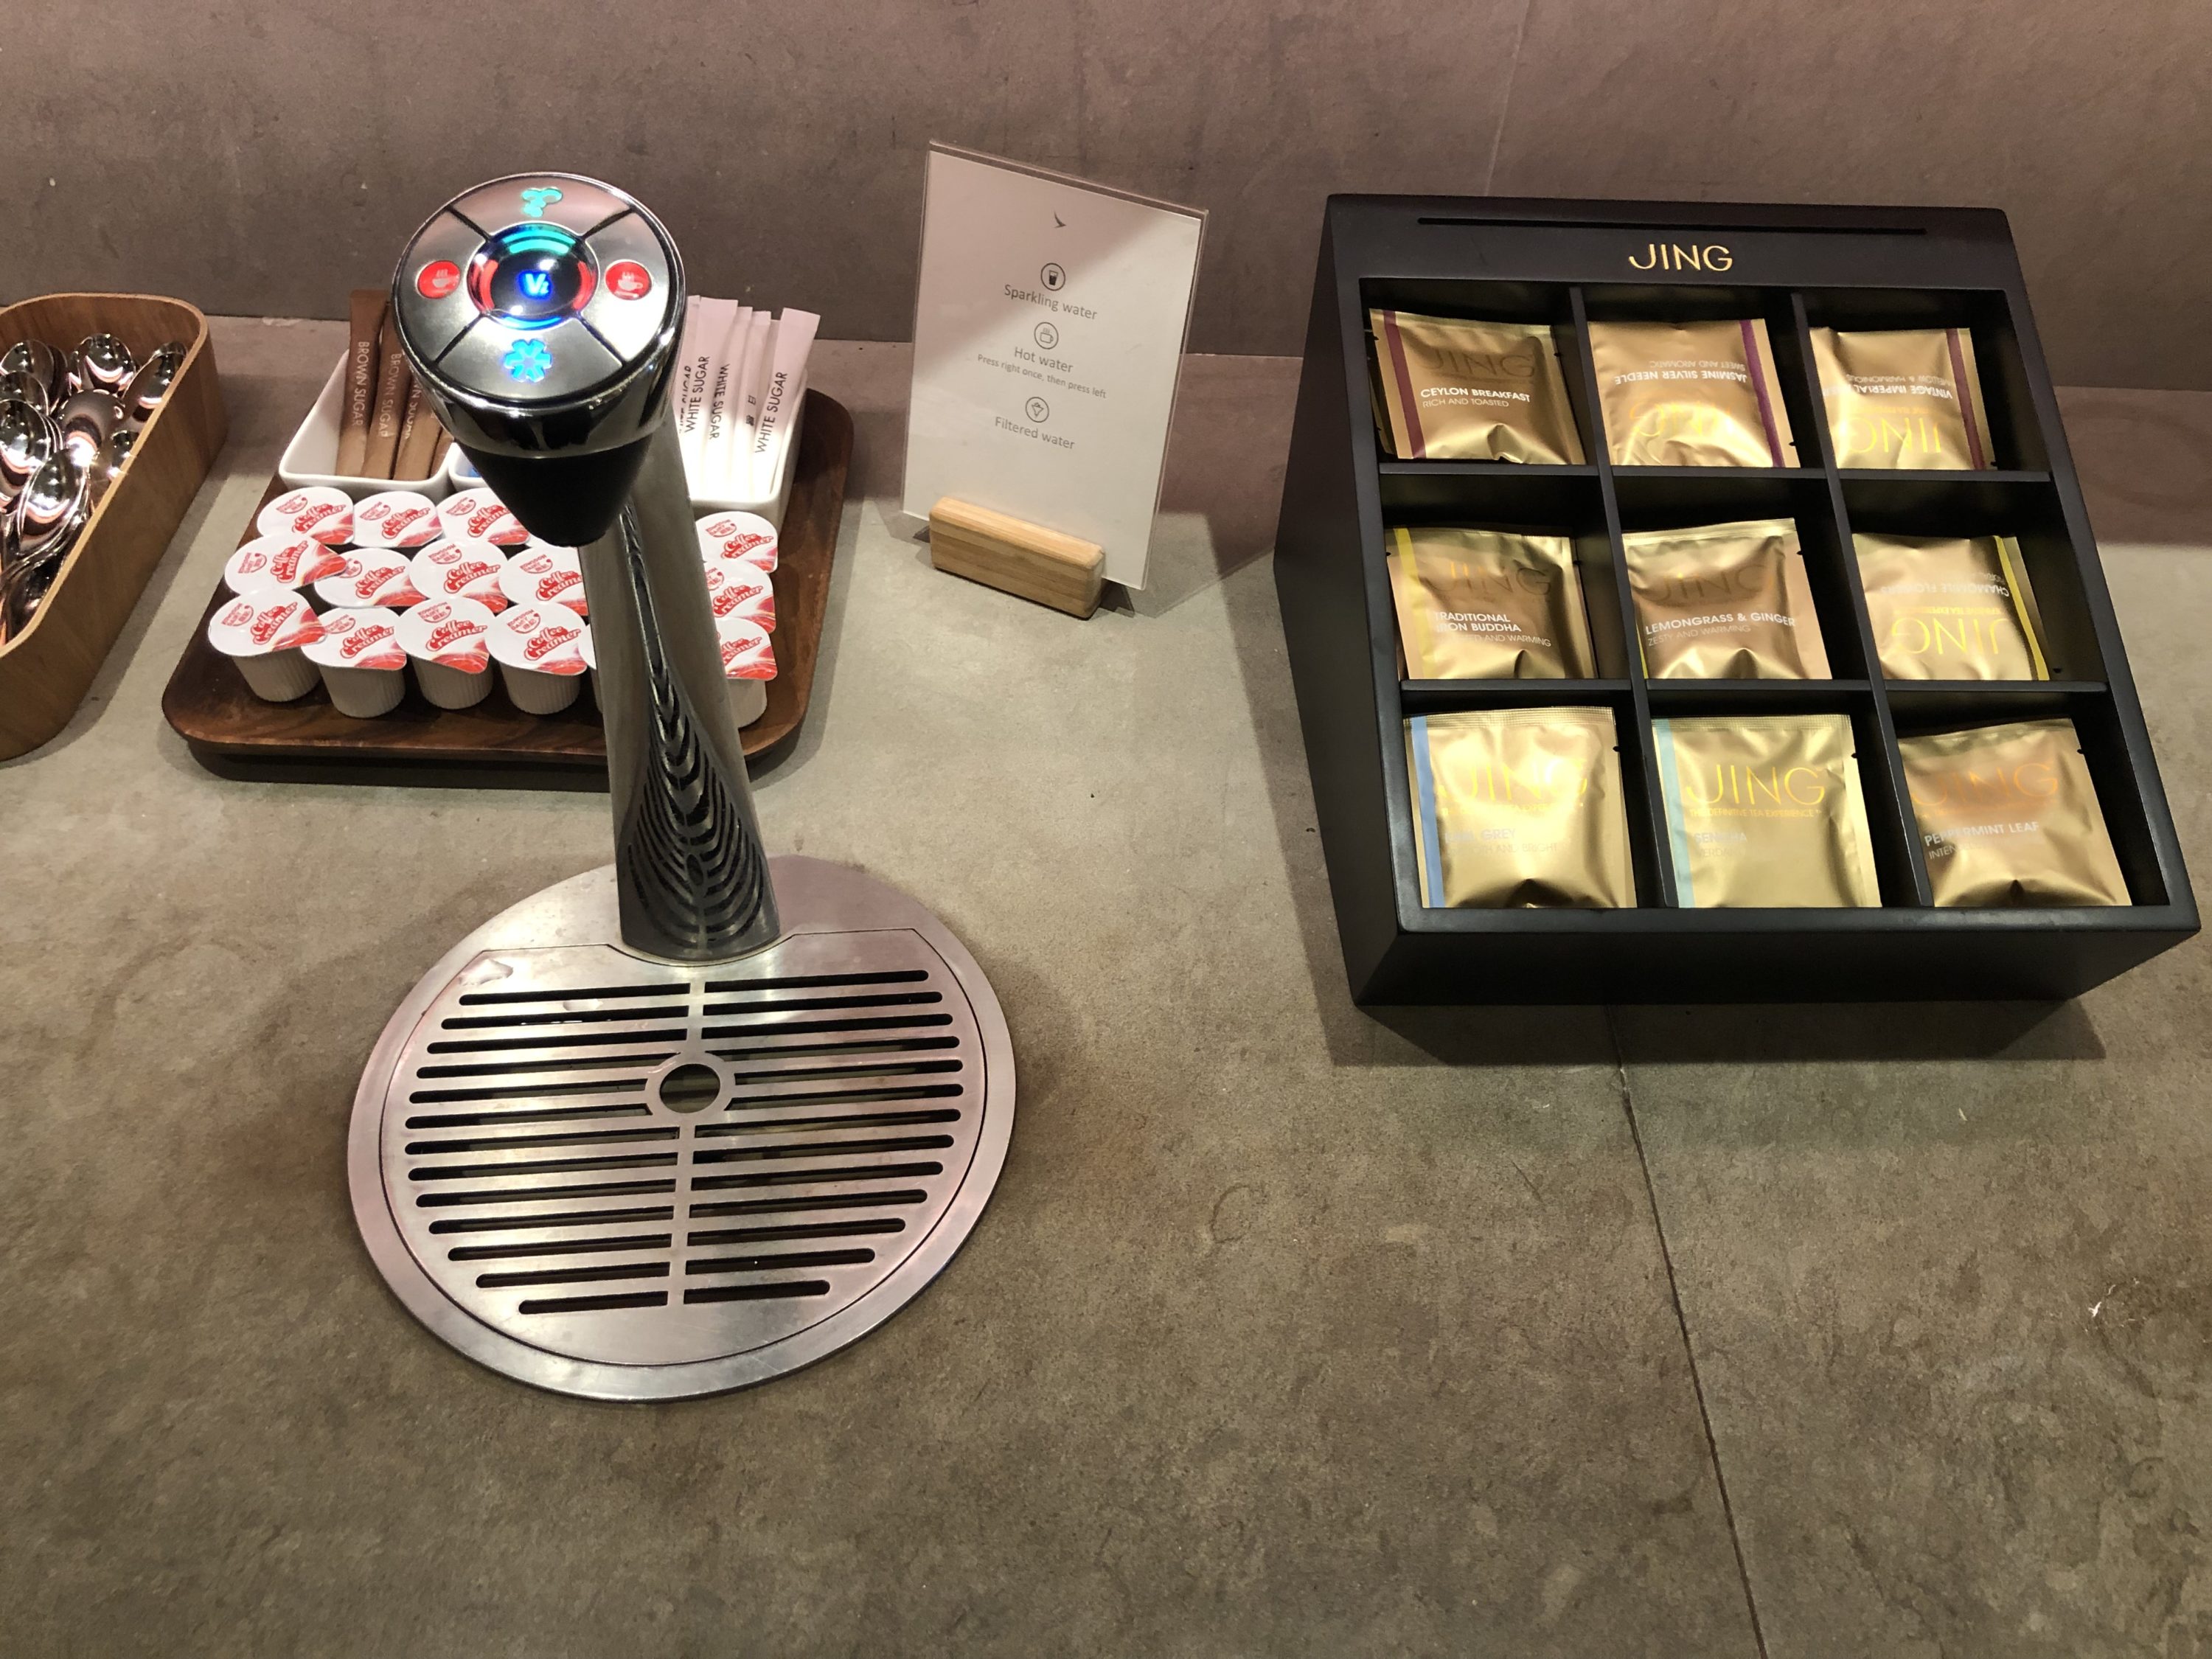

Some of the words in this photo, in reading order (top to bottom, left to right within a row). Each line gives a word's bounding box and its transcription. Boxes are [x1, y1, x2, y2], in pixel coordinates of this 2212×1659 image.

[1629, 244, 1732, 271] JING
[1004, 284, 1058, 312] Sparkling
[1062, 303, 1097, 319] water
[355, 341, 369, 386] BROWN
[1015, 347, 1035, 363] Hot
[1039, 356, 1074, 372] water
[1698, 361, 1719, 369] AND
[384, 353, 402, 395] BROWN
[692, 356, 710, 393] SUGAR
[714, 364, 730, 397] WHITE
[978, 354, 999, 367] Press
[1001, 361, 1020, 374] right
[1023, 368, 1044, 381] once,
[1047, 375, 1066, 386] then
[1068, 381, 1090, 394] press
[1093, 387, 1106, 398] left
[1615, 371, 1658, 385] NEEDLE
[1663, 370, 1699, 380] SILVER
[1702, 370, 1747, 383] JASMINE
[1420, 387, 1469, 398] CEYLON
[1471, 389, 1530, 403] BREAKFAST
[1854, 384, 1906, 394] IMPERIAL
[1911, 386, 1952, 399] VINTAGE
[352, 388, 366, 425] SUGAR
[684, 397, 701, 433] WHITE
[755, 416, 776, 453] WHITE
[767, 372, 787, 412] SUGAR
[1422, 398, 1446, 408] RICH
[1448, 397, 1469, 406] AND
[1471, 398, 1509, 407] TOASTED
[709, 401, 723, 439] SUGAR
[995, 417, 1038, 438] Filtered
[1042, 433, 1075, 449] water
[467, 507, 511, 538] Creame
[447, 561, 484, 579] Coffee
[536, 575, 582, 601] Creame
[1435, 611, 1510, 622] TRADITIONAL
[1472, 622, 1521, 632] BUDDHA
[1646, 613, 1733, 635] LEMONGRASS
[1737, 613, 1747, 622] &
[1750, 612, 1796, 627] GINGER
[343, 625, 379, 647] Coffee
[426, 625, 487, 651] Creamer
[432, 620, 470, 640] Coffee
[527, 626, 563, 648] Coffee
[1485, 634, 1505, 642] AND
[1508, 634, 1551, 647] WARMING
[1648, 634, 1673, 647] ZESTY
[1677, 629, 1698, 639] AND
[1701, 625, 1751, 635] WARMING
[1891, 617, 2009, 654] JING
[524, 629, 581, 661] Creamer
[723, 637, 762, 665] reamer
[1686, 764, 1825, 806] JING
[1481, 828, 1517, 840] GREY
[1924, 824, 2005, 846] PEPPERMINT
[2008, 821, 2039, 834] LEAF
